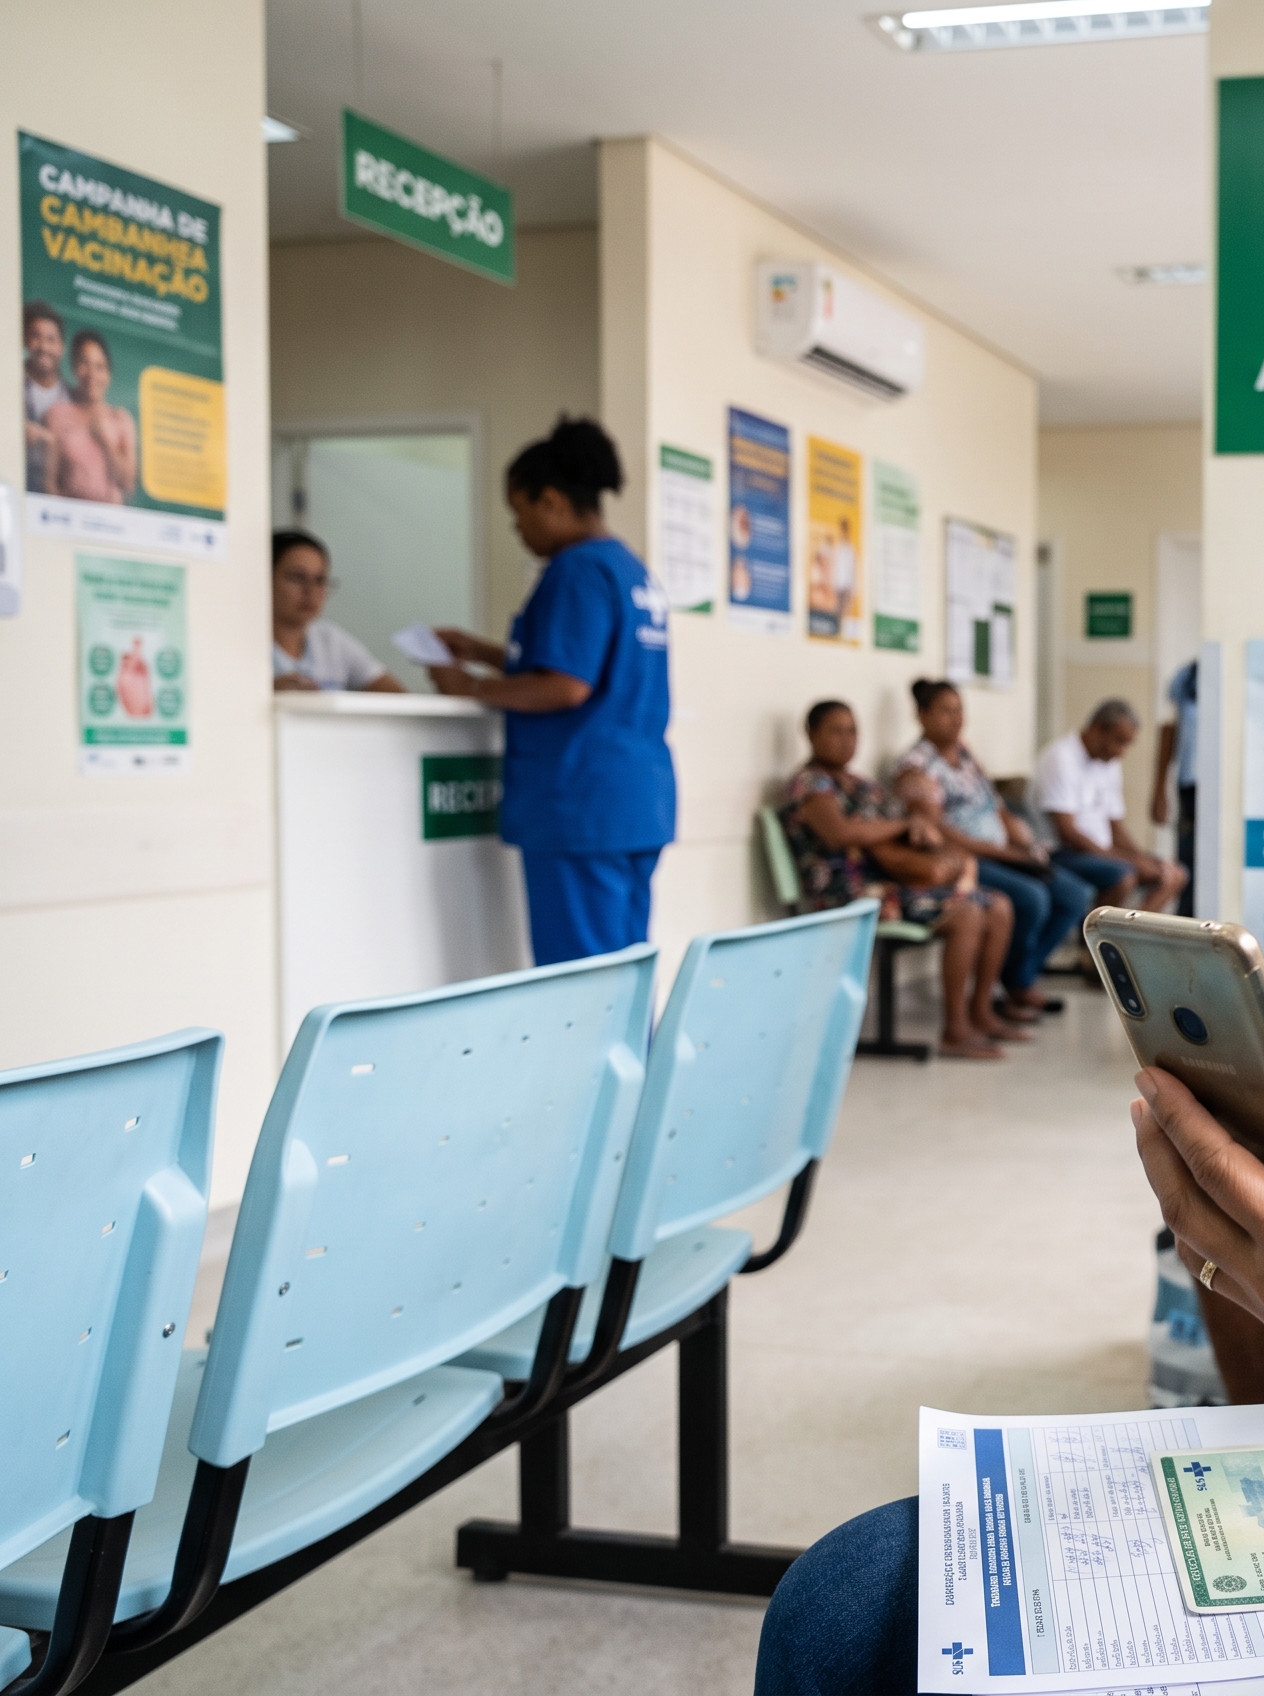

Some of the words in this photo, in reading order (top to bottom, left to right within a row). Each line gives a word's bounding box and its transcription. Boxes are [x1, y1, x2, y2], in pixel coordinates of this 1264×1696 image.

[38, 163, 175, 233] CAMPANHA
[177, 210, 209, 245] DE
[355, 148, 504, 248] RECEPÇÃO
[41, 226, 210, 304] VACINAÇÃO
